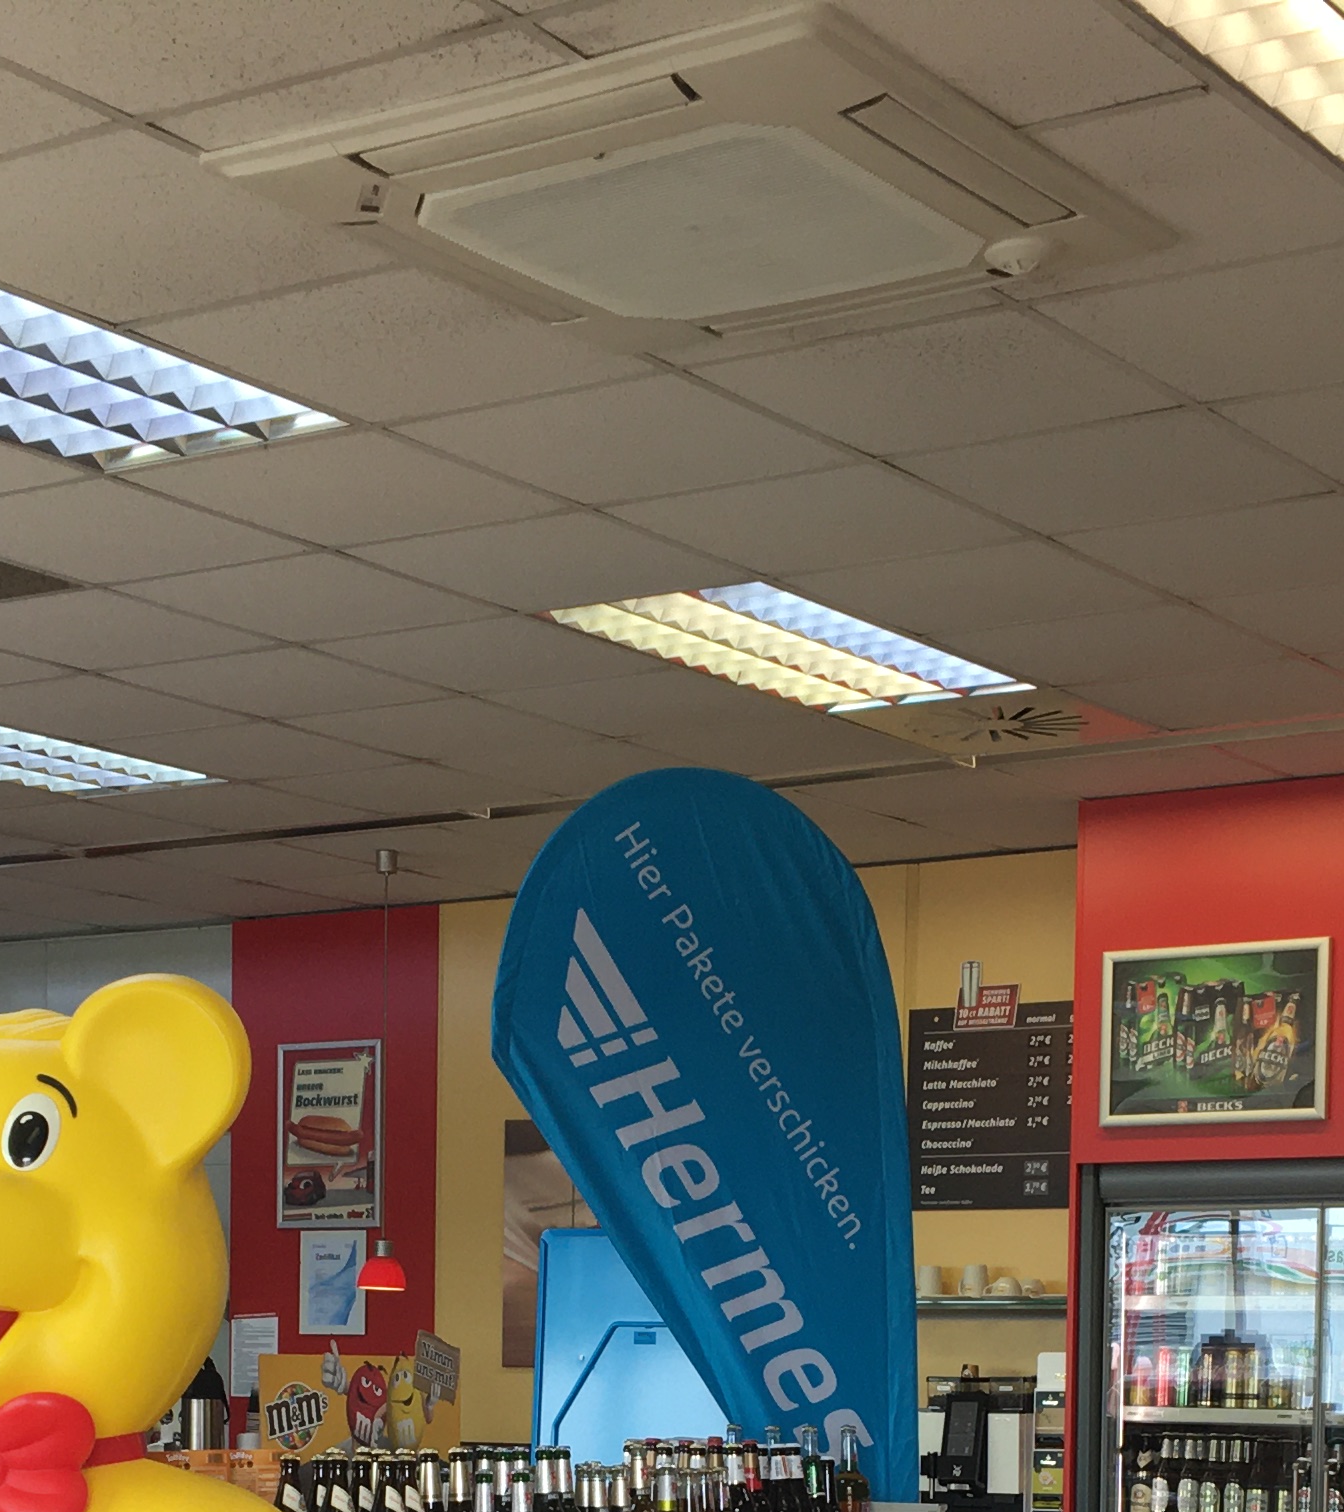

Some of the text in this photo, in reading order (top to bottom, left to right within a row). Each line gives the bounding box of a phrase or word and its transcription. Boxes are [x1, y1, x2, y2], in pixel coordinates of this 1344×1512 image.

[982, 995, 1010, 1004] SPART!
[959, 1009, 968, 1019] 10
[978, 1006, 1010, 1017] RABATT
[1026, 1014, 1055, 1024] normal
[615, 821, 863, 1251] Hier Pakete verschicken.
[923, 1081, 946, 1090] Latte
[295, 1093, 358, 1107] Bockwurst
[1197, 1100, 1243, 1111] BECK'S
[921, 1163, 1003, 1175] Heiße Schokolade
[921, 1185, 936, 1195] Tee
[589, 1054, 873, 1466] Hermes
[421, 1341, 454, 1369] Nimm
[416, 1362, 456, 1389] uns mit!
